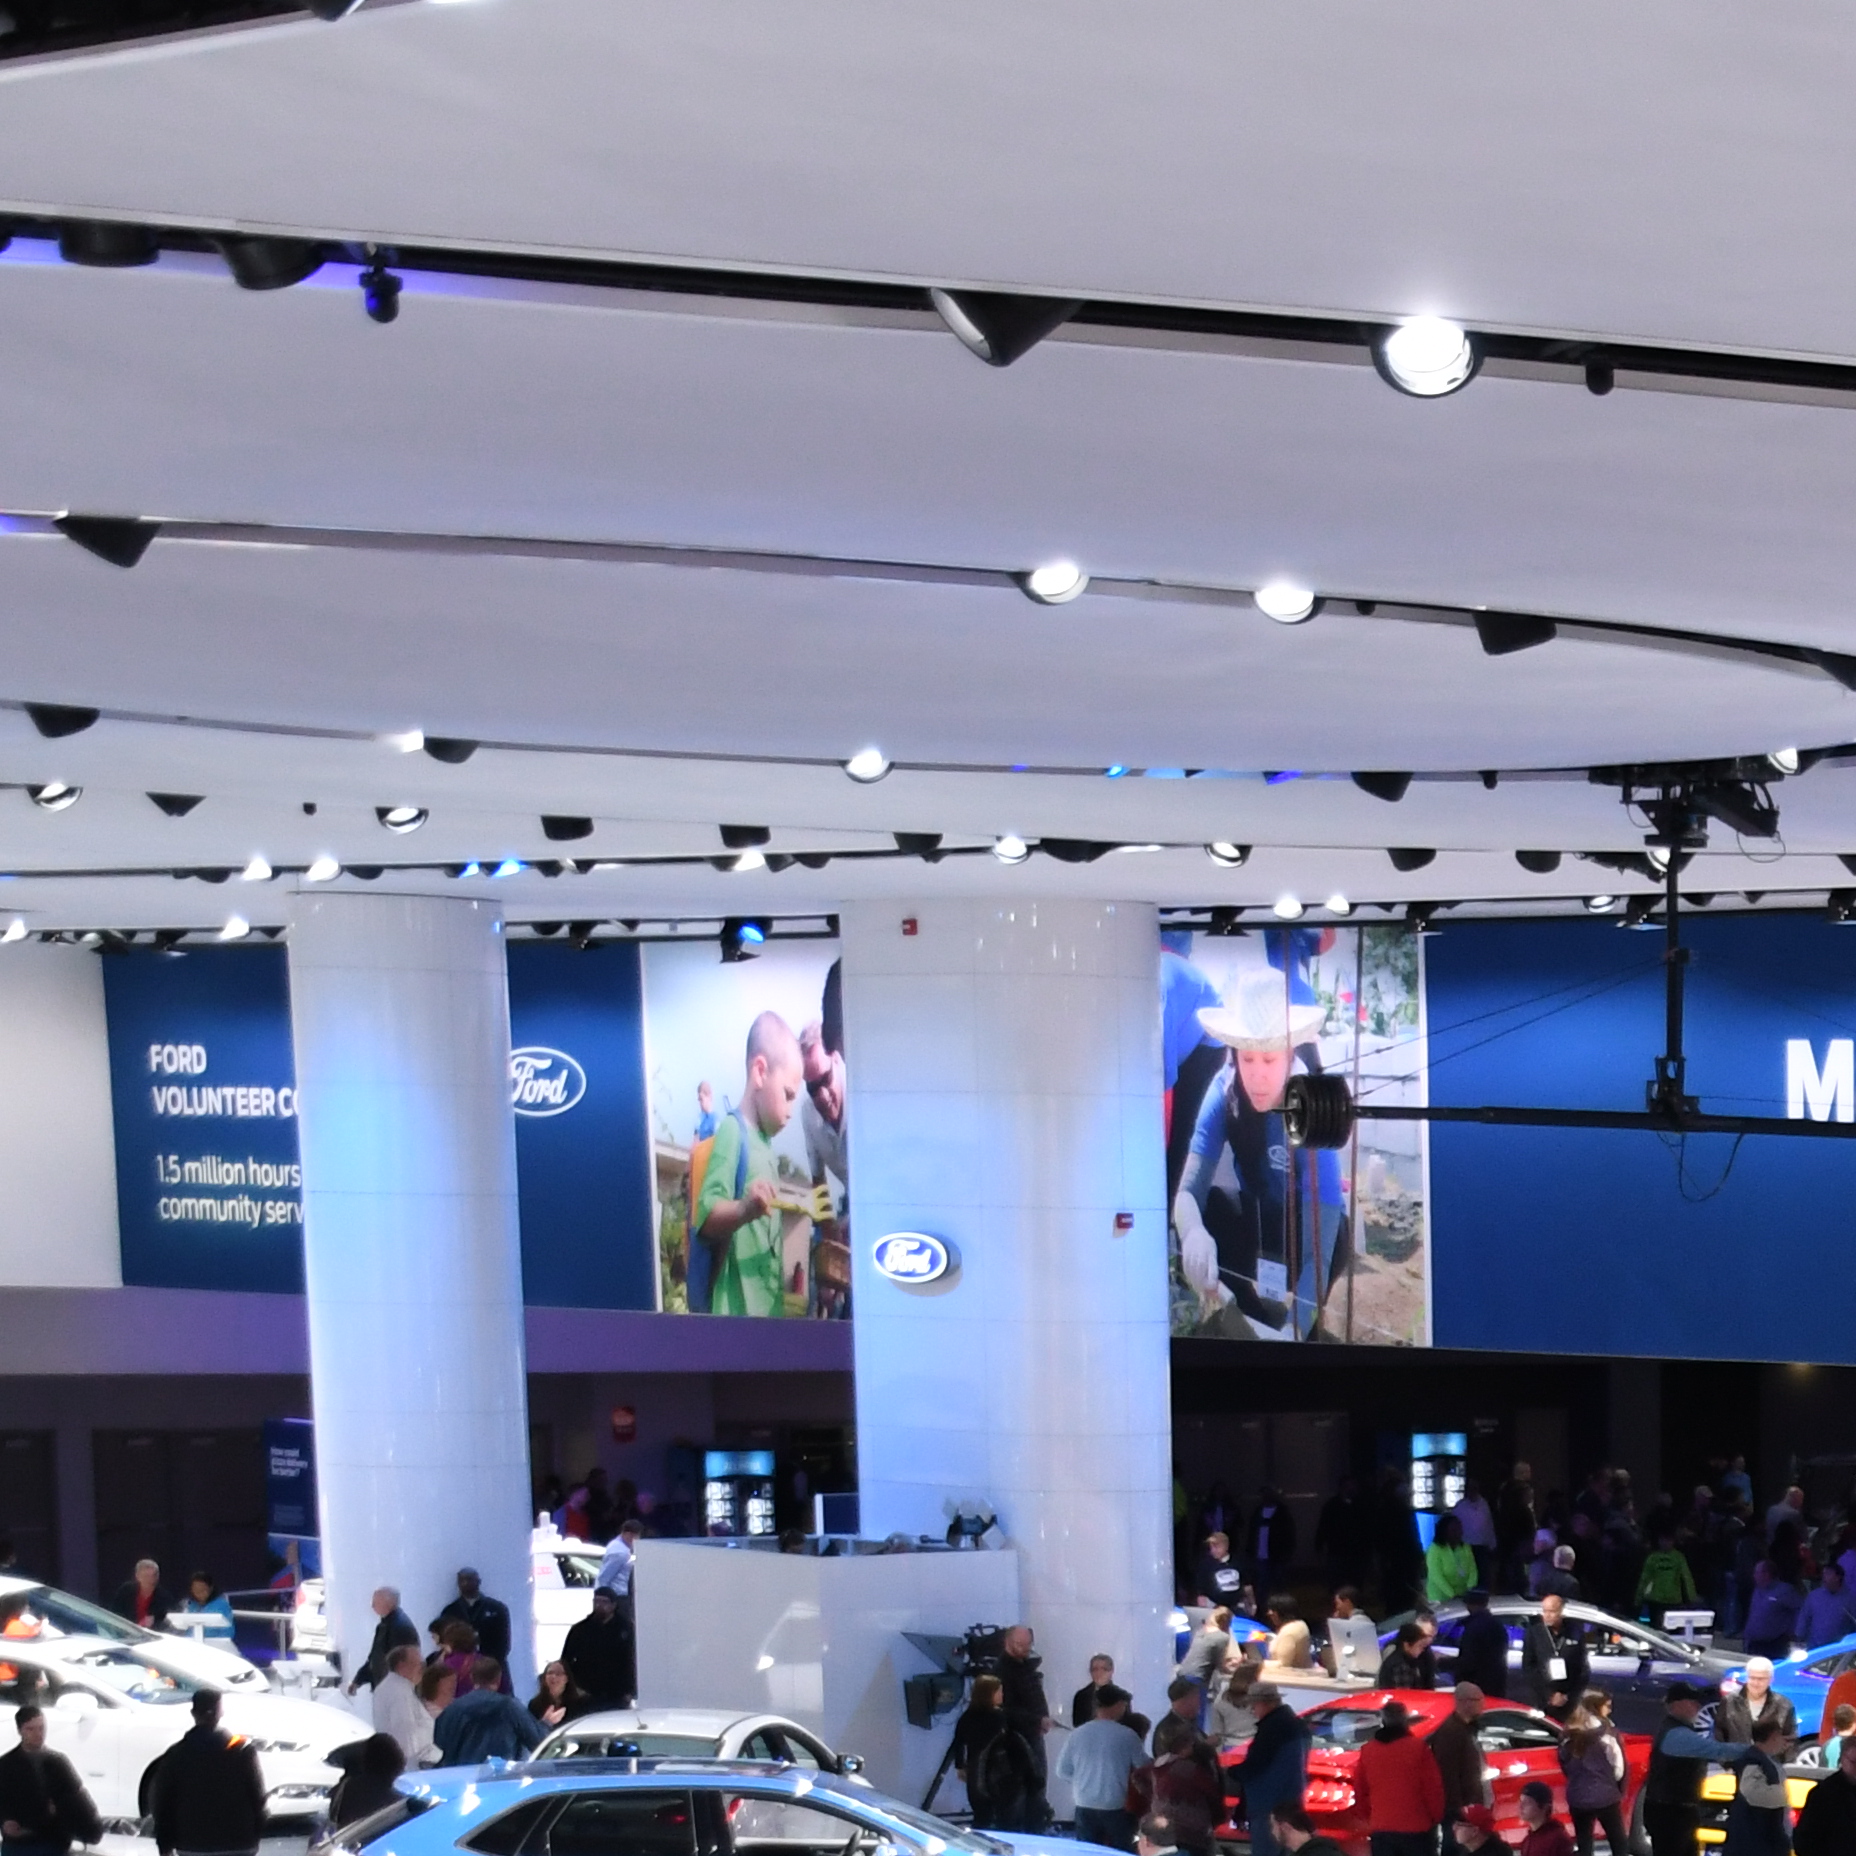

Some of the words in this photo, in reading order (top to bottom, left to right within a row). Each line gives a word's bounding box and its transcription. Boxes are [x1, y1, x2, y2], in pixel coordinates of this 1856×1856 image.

[150, 1044, 207, 1074] FORD
[152, 1086, 276, 1117] VOLUNTEER
[156, 1155, 182, 1184] 1.5
[184, 1155, 246, 1186] million
[249, 1156, 302, 1187] hours
[159, 1194, 263, 1229] community
